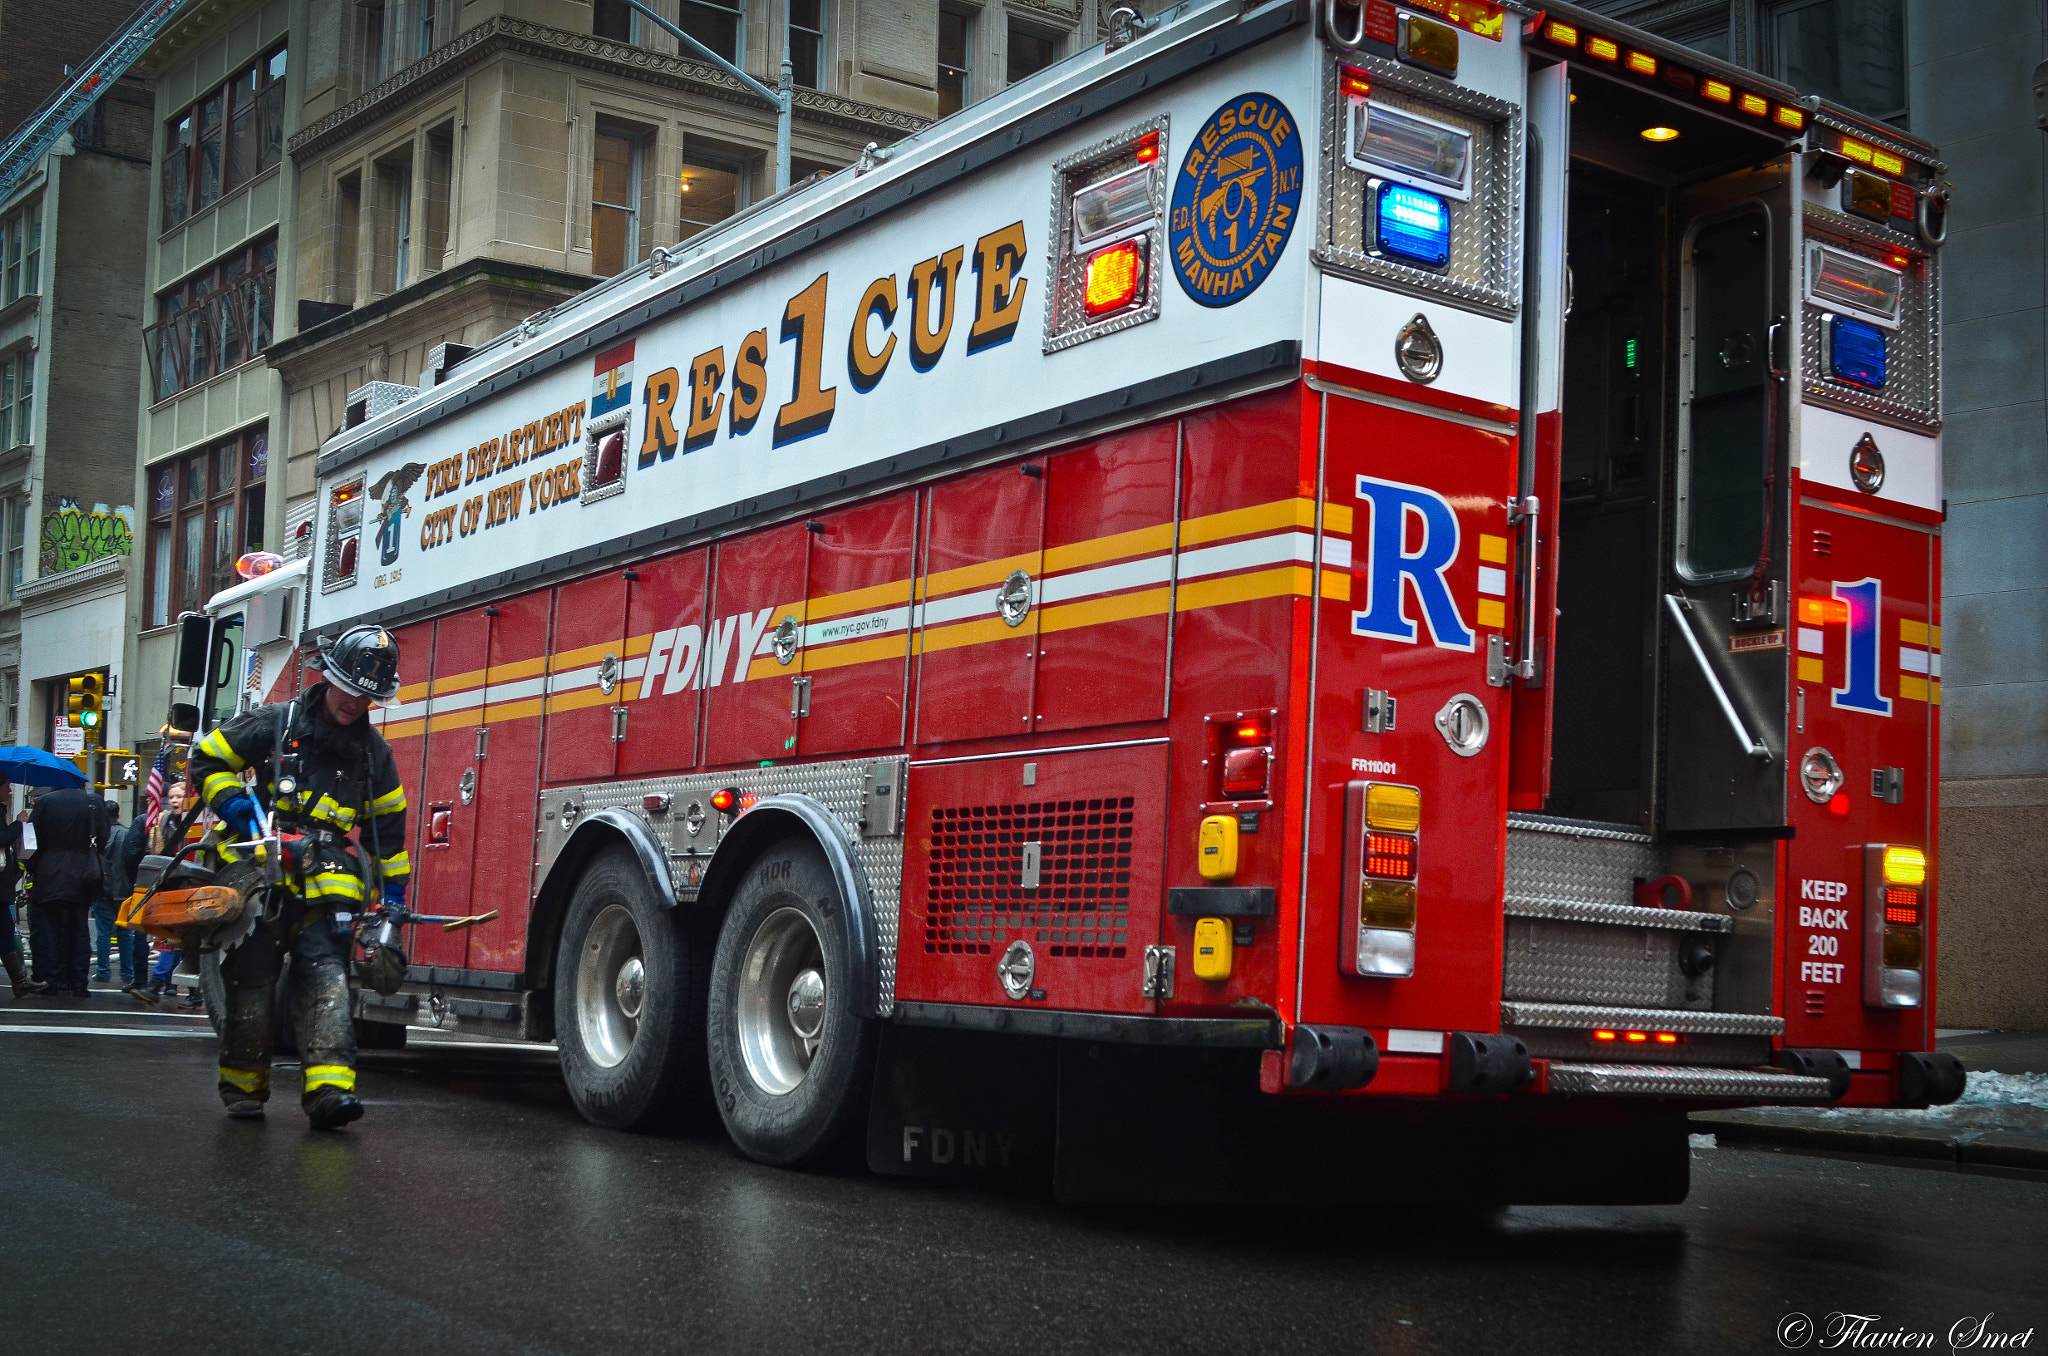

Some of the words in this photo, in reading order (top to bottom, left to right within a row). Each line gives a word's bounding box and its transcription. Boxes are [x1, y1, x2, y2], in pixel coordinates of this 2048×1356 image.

[1185, 100, 1292, 179] RESCUE
[1279, 165, 1300, 195] N.Y.
[1172, 206, 1191, 233] F.D.
[1177, 203, 1293, 297] MANHATTAN
[1223, 220, 1239, 255] 1
[425, 453, 463, 502] FIRE
[465, 400, 587, 486] DEPARTMENT
[420, 507, 457, 552] CITY
[460, 496, 484, 538] OF
[485, 479, 526, 530] NEW
[529, 457, 584, 515] YORK
[386, 522, 395, 553] 1
[1351, 474, 1476, 653] R
[821, 616, 889, 638] www.nyc.gov.fdny
[639, 606, 775, 700] FDNY
[1830, 576, 1893, 717] 1
[1351, 757, 1397, 775] FR11001
[1801, 879, 1848, 903] KEEP
[1800, 907, 1849, 930] BACK
[1808, 935, 1839, 956] 200
[1801, 962, 1845, 984] FEET
[903, 1125, 1013, 1168] FDNY
